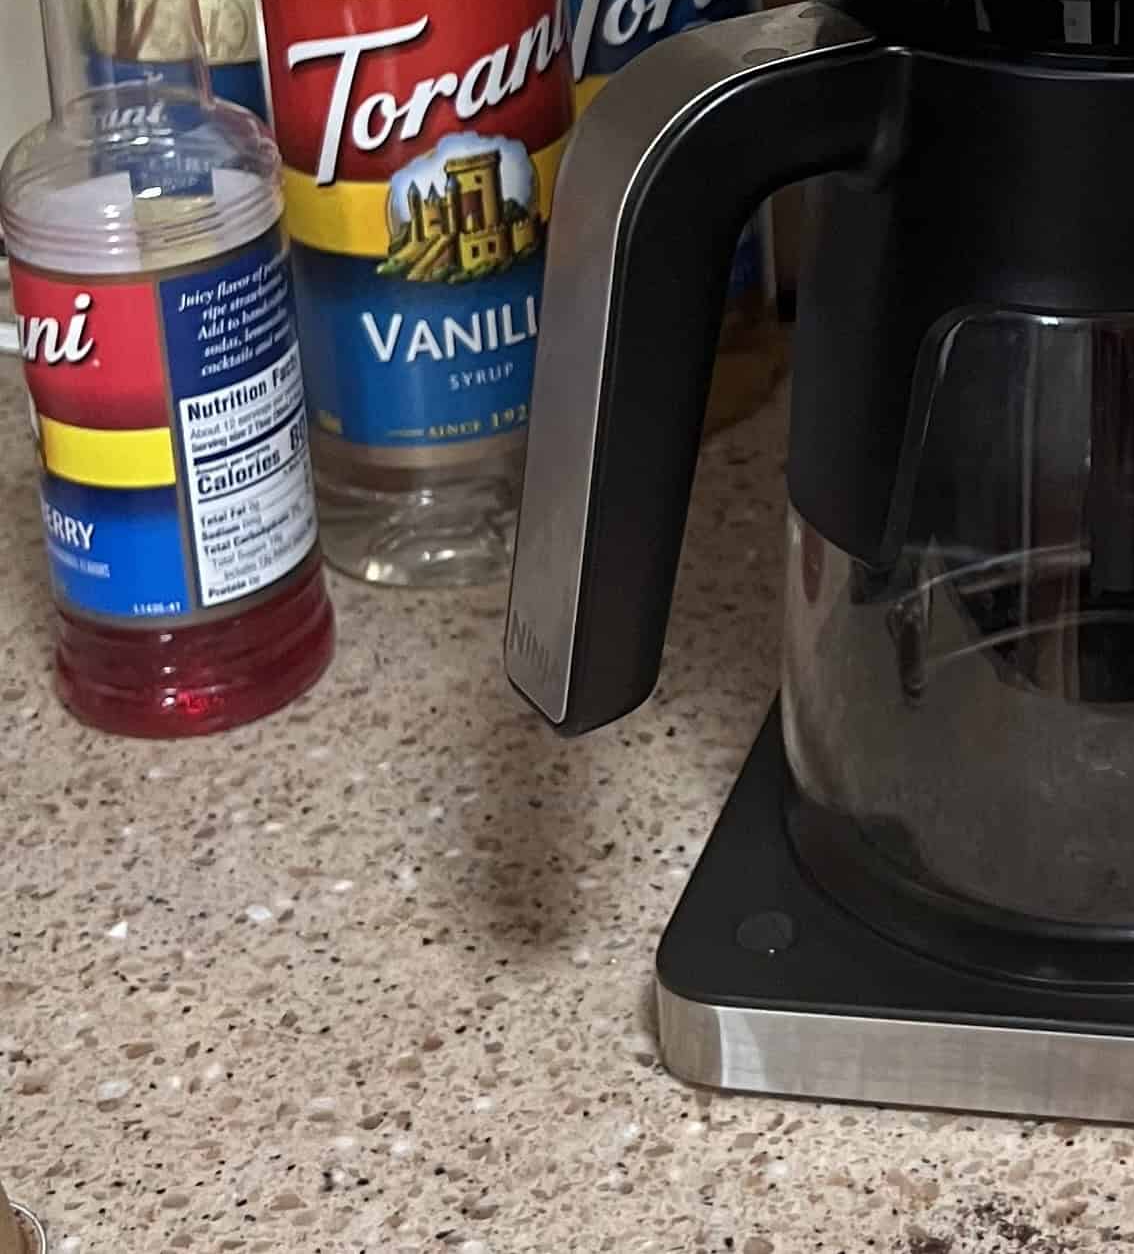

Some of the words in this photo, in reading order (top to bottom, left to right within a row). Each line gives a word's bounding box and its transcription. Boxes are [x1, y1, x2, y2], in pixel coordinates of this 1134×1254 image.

[178, 289, 214, 314] Juicy
[216, 275, 250, 302] flavor
[202, 303, 228, 321] ripe
[197, 316, 225, 341] Add
[227, 317, 240, 332] to
[201, 345, 254, 377] cocktails
[449, 361, 514, 391] SYRUP
[187, 380, 267, 422] Nutrition
[190, 422, 220, 440] About
[427, 418, 482, 439] SINCE
[191, 435, 228, 454] Serving
[197, 447, 281, 495] Calories
[201, 509, 228, 528] Total
[204, 537, 231, 556] Total
[208, 579, 246, 599] Protein
